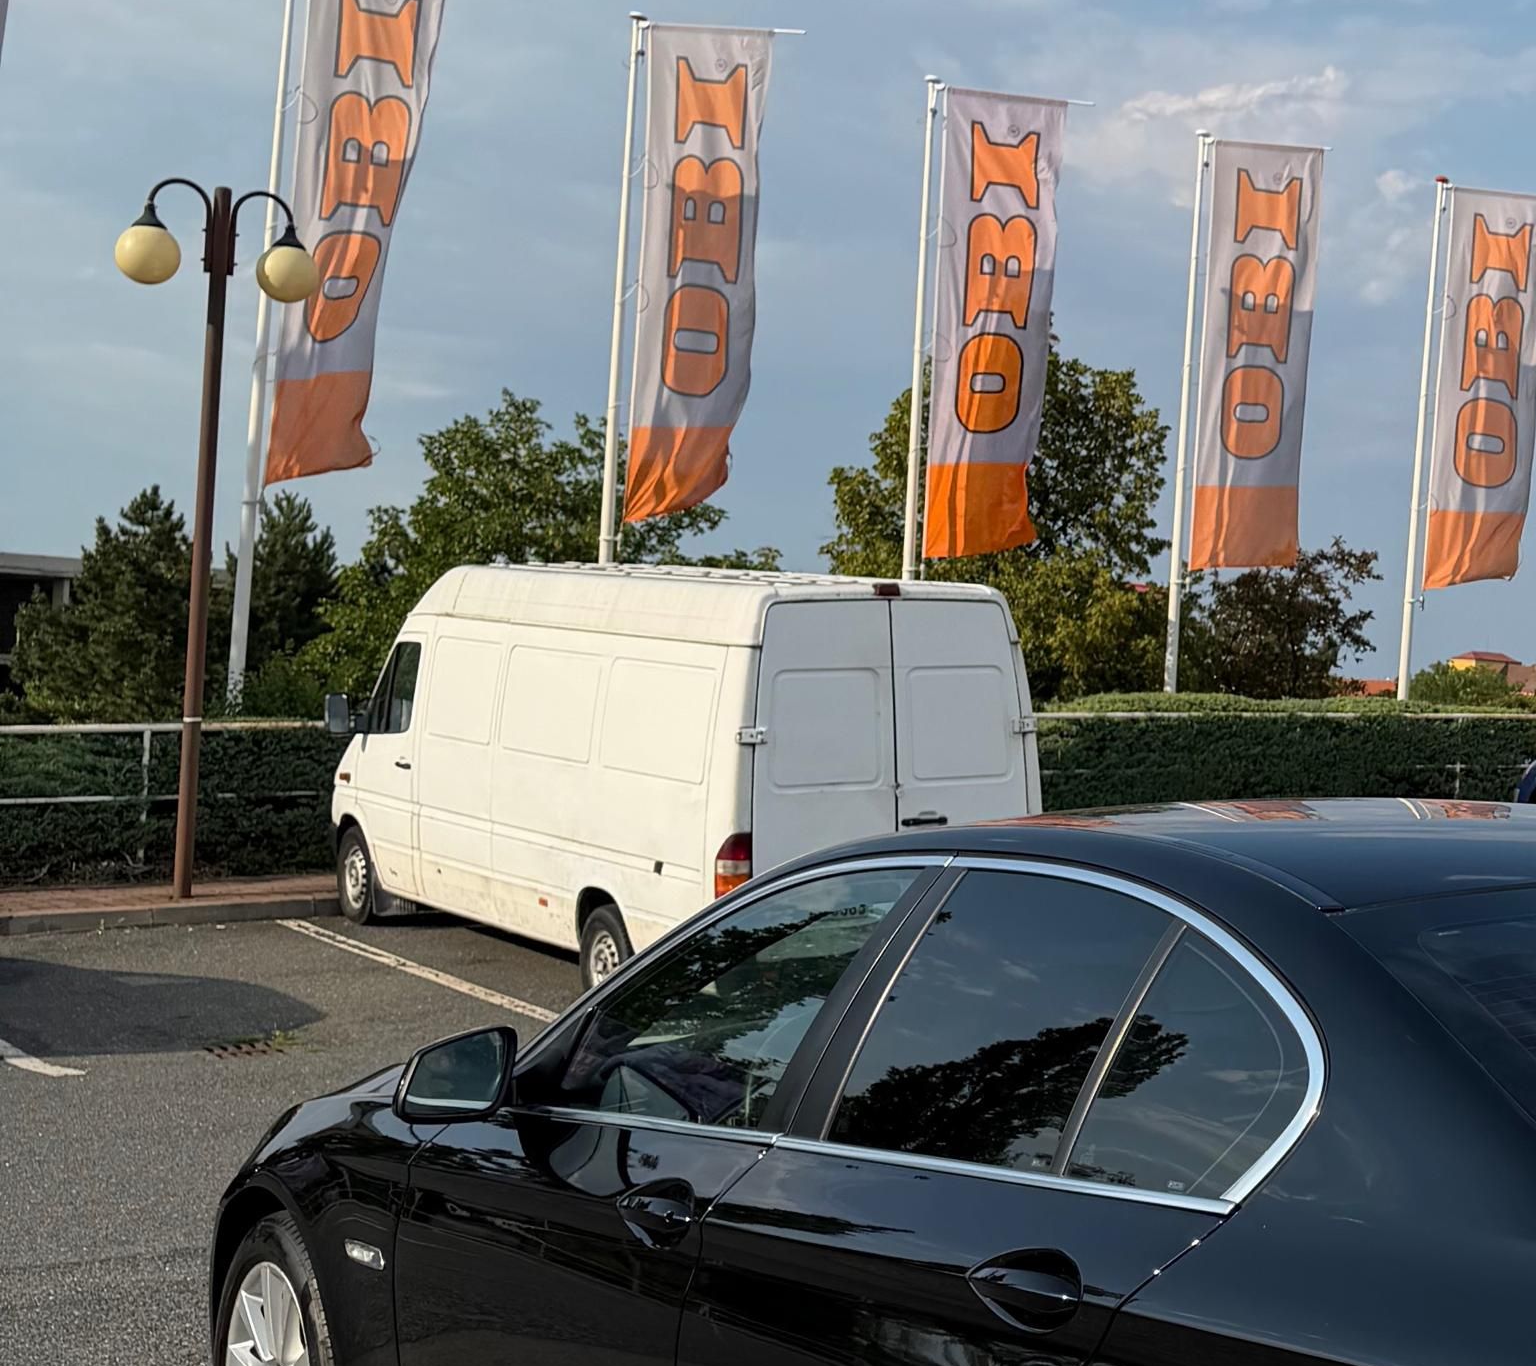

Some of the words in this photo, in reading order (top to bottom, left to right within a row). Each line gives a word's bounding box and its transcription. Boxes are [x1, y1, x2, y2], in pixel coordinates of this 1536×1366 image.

[660, 57, 749, 398] OBI
[954, 121, 1041, 434] OBI
[1219, 168, 1304, 460] OBI
[1453, 213, 1534, 489] OBI
